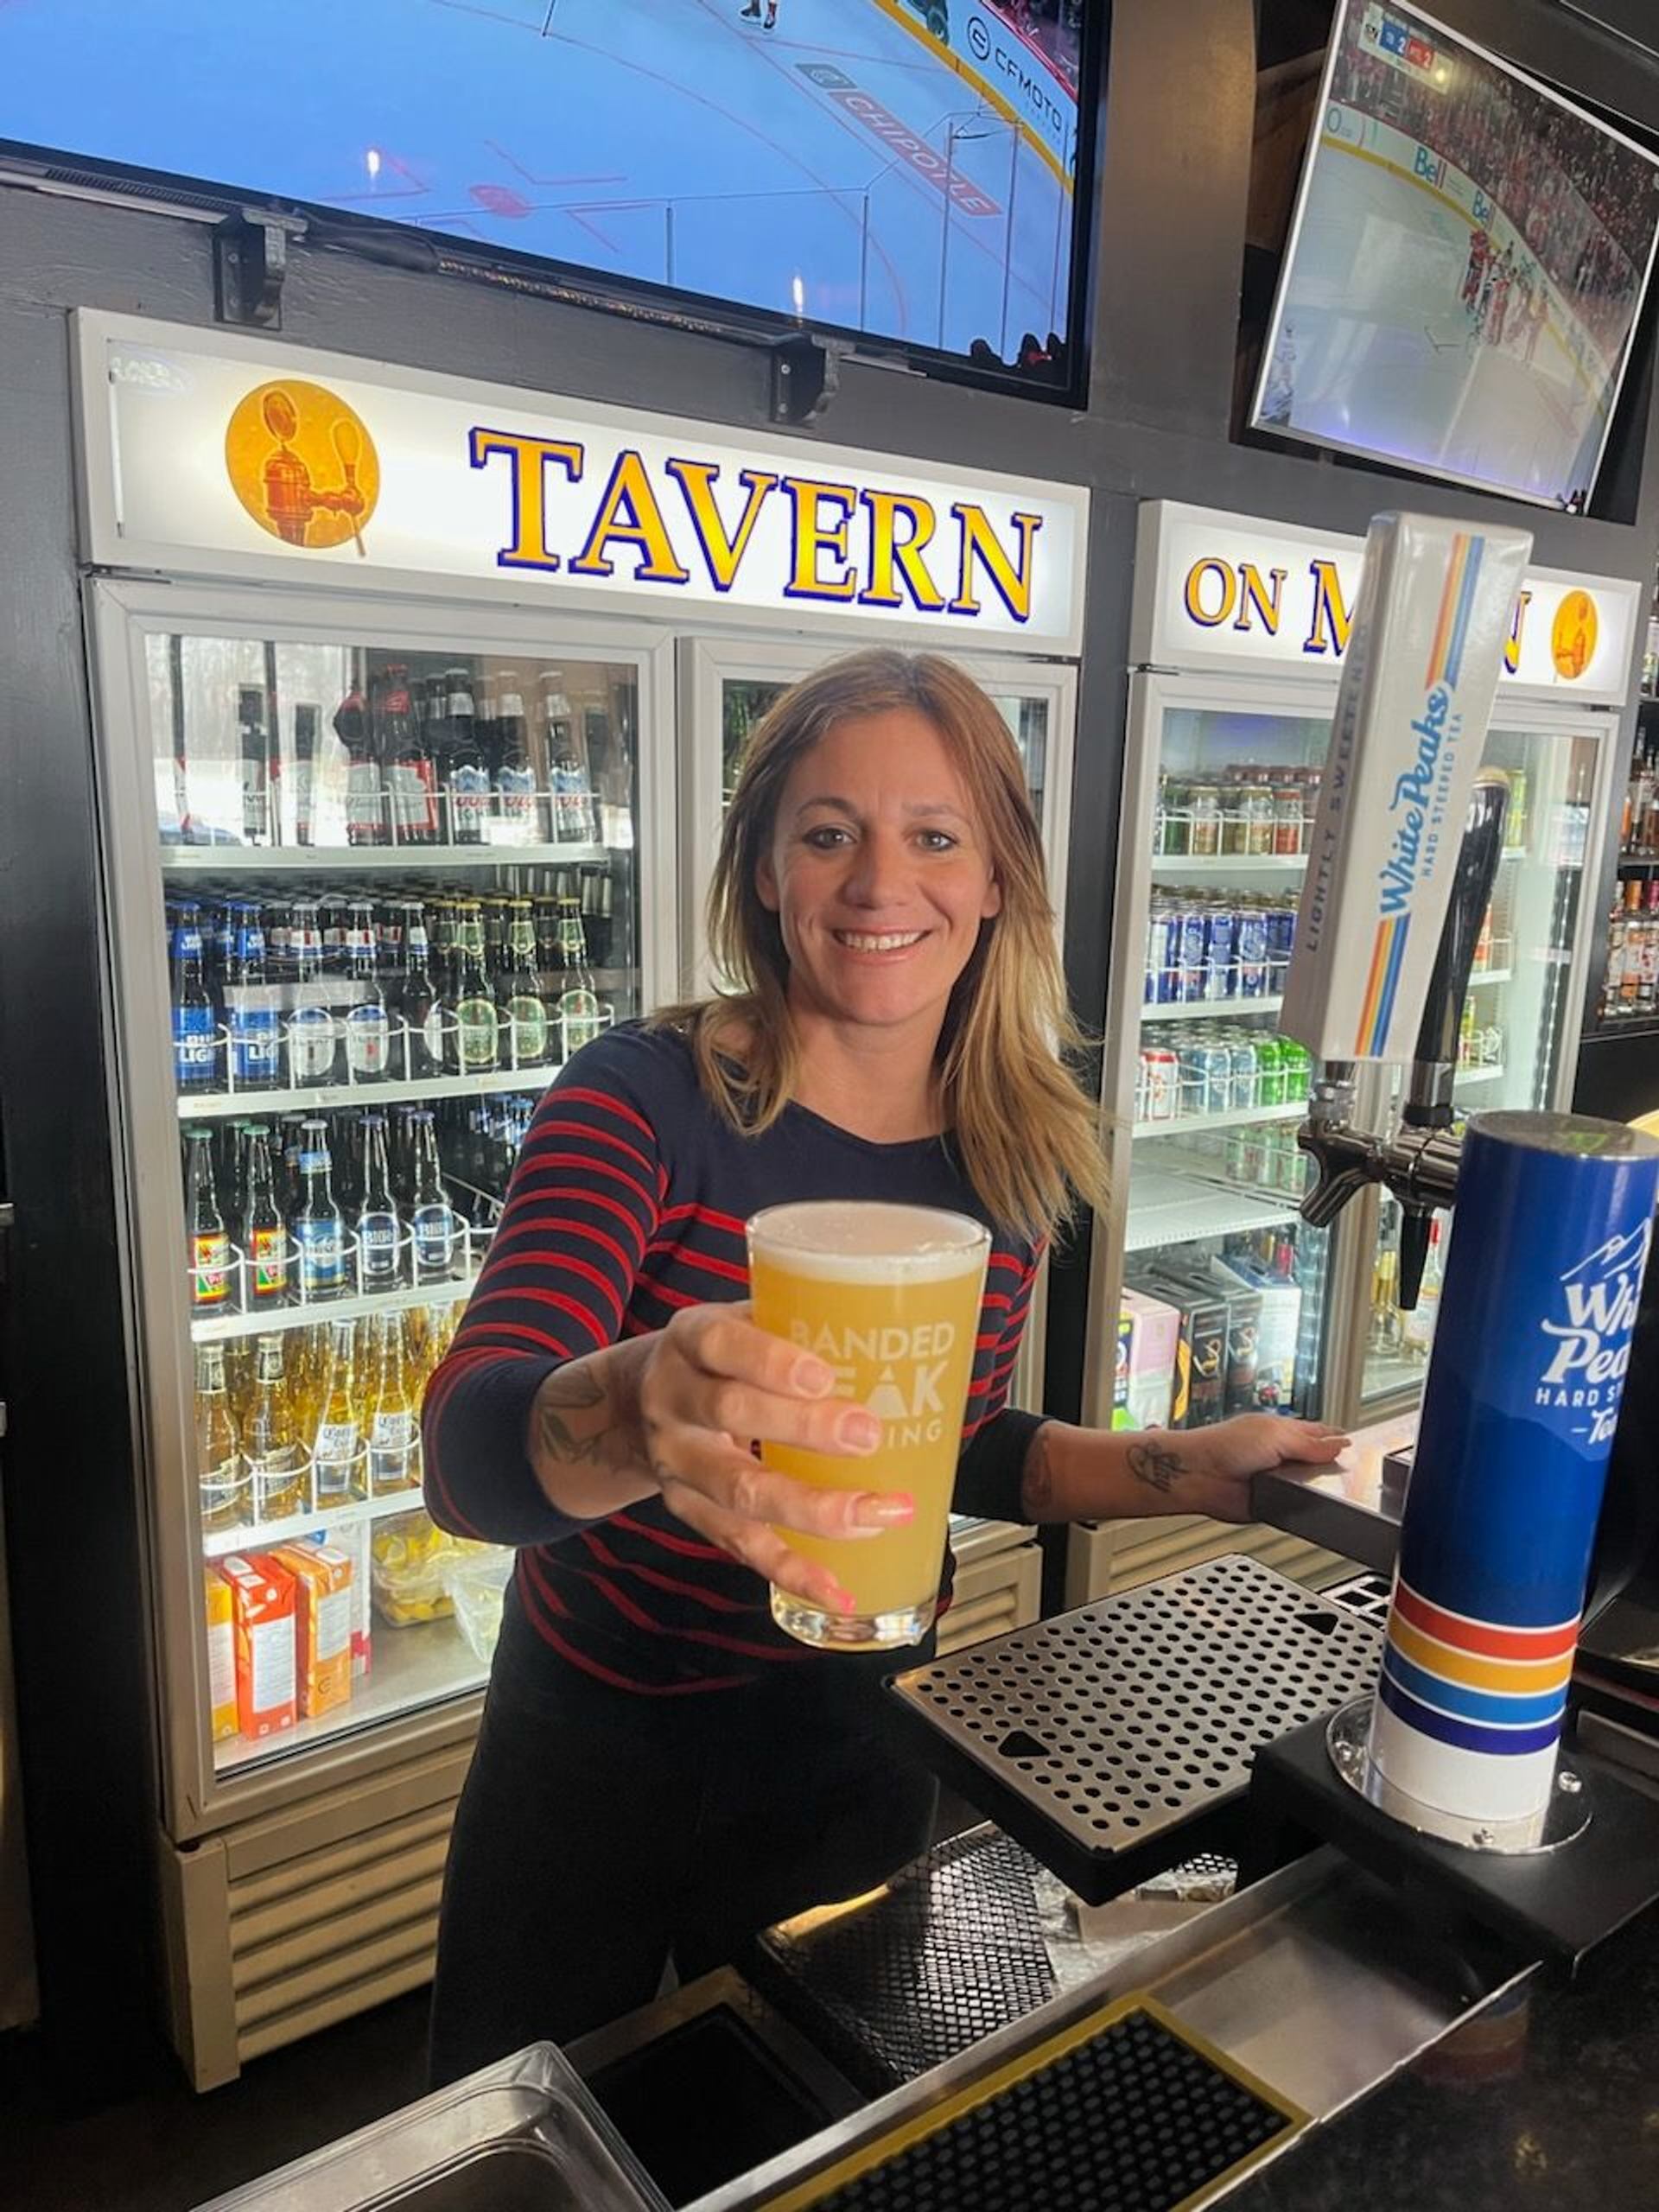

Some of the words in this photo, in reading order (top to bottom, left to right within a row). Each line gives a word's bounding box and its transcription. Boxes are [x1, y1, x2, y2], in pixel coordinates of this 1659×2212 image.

[995, 47, 1063, 132] CFMOTO
[844, 94, 992, 212] CHIPOTLE
[1414, 145, 1447, 189] Bell
[468, 427, 1042, 621] TAVERN
[1185, 556, 1287, 636] ON
[1389, 687, 1449, 810] Peaks
[1422, 832, 1439, 877] HARD
[1431, 753, 1455, 824] STEEPED
[1447, 713, 1463, 743] TEA
[1306, 829, 1337, 953] LIGHTLY
[1378, 807, 1425, 913] White
[790, 1319, 956, 1362] BANDED
[1535, 1387, 1599, 1408] HARD
